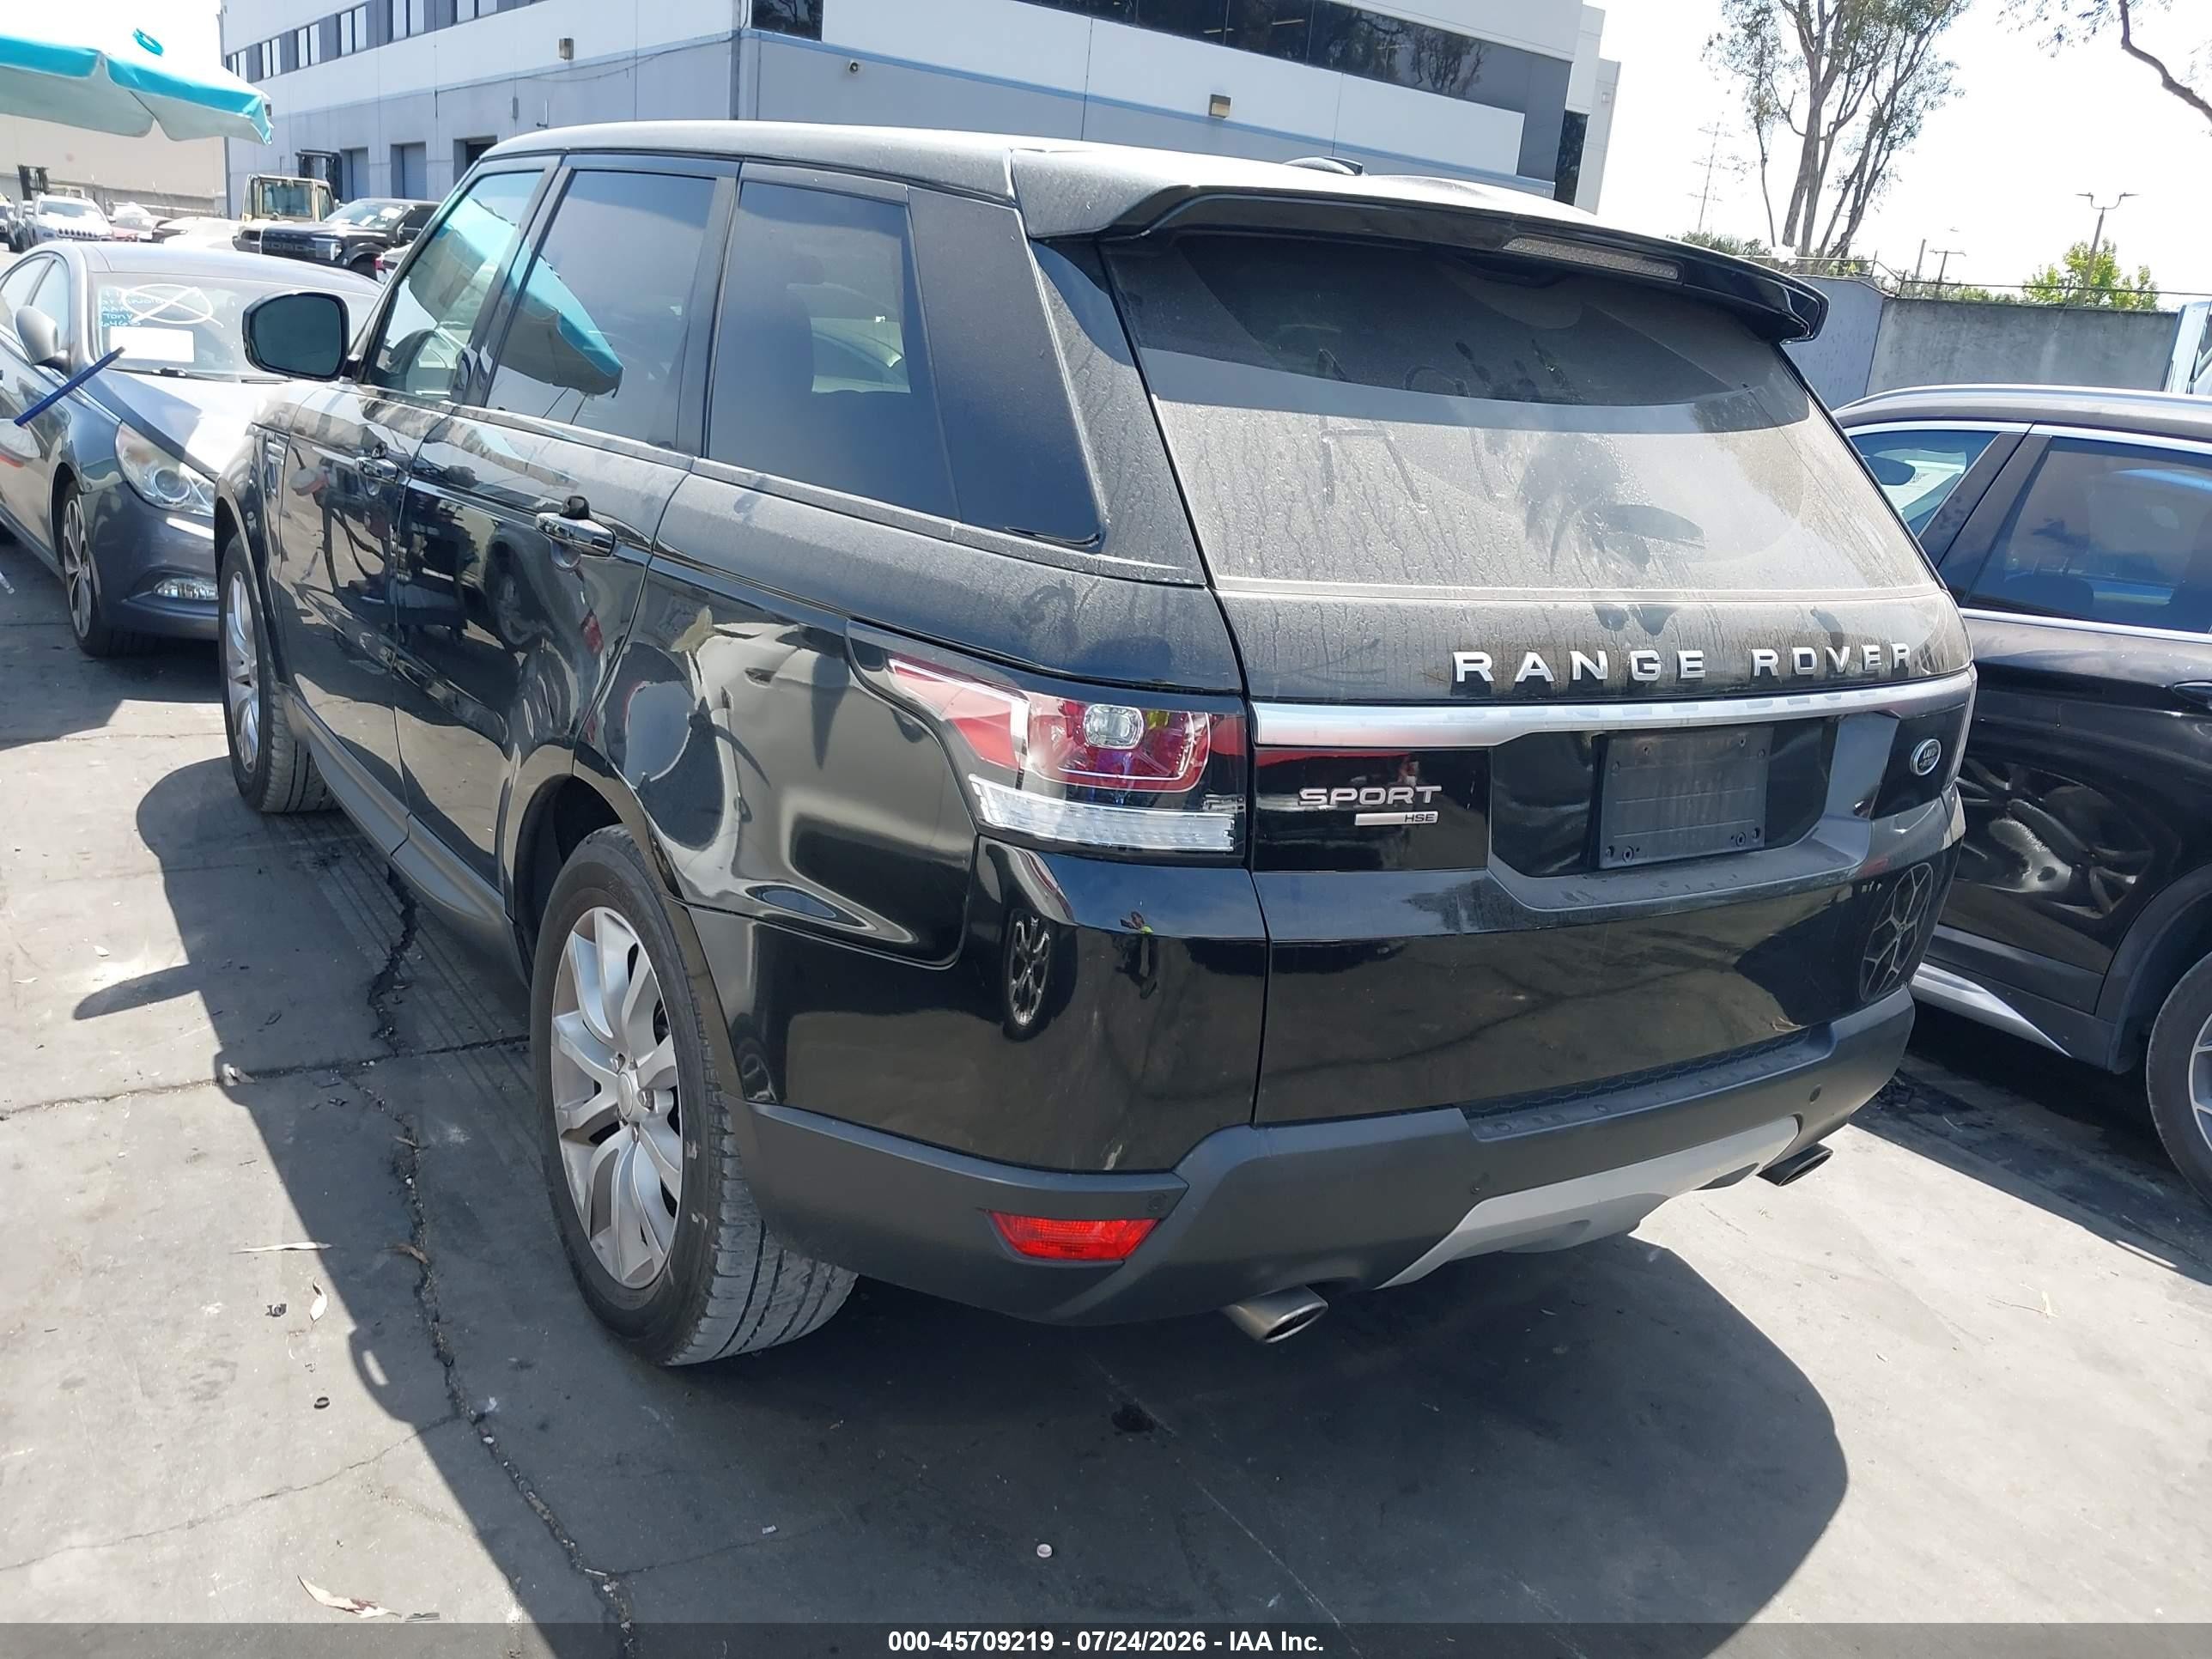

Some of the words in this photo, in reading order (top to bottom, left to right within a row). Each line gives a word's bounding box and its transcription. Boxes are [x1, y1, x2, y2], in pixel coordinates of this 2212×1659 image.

[1453, 650, 1707, 683] RANGE
[1752, 642, 1911, 678] ROVER
[1298, 785, 1443, 805] SPORT
[1404, 813, 1436, 823] HSE
